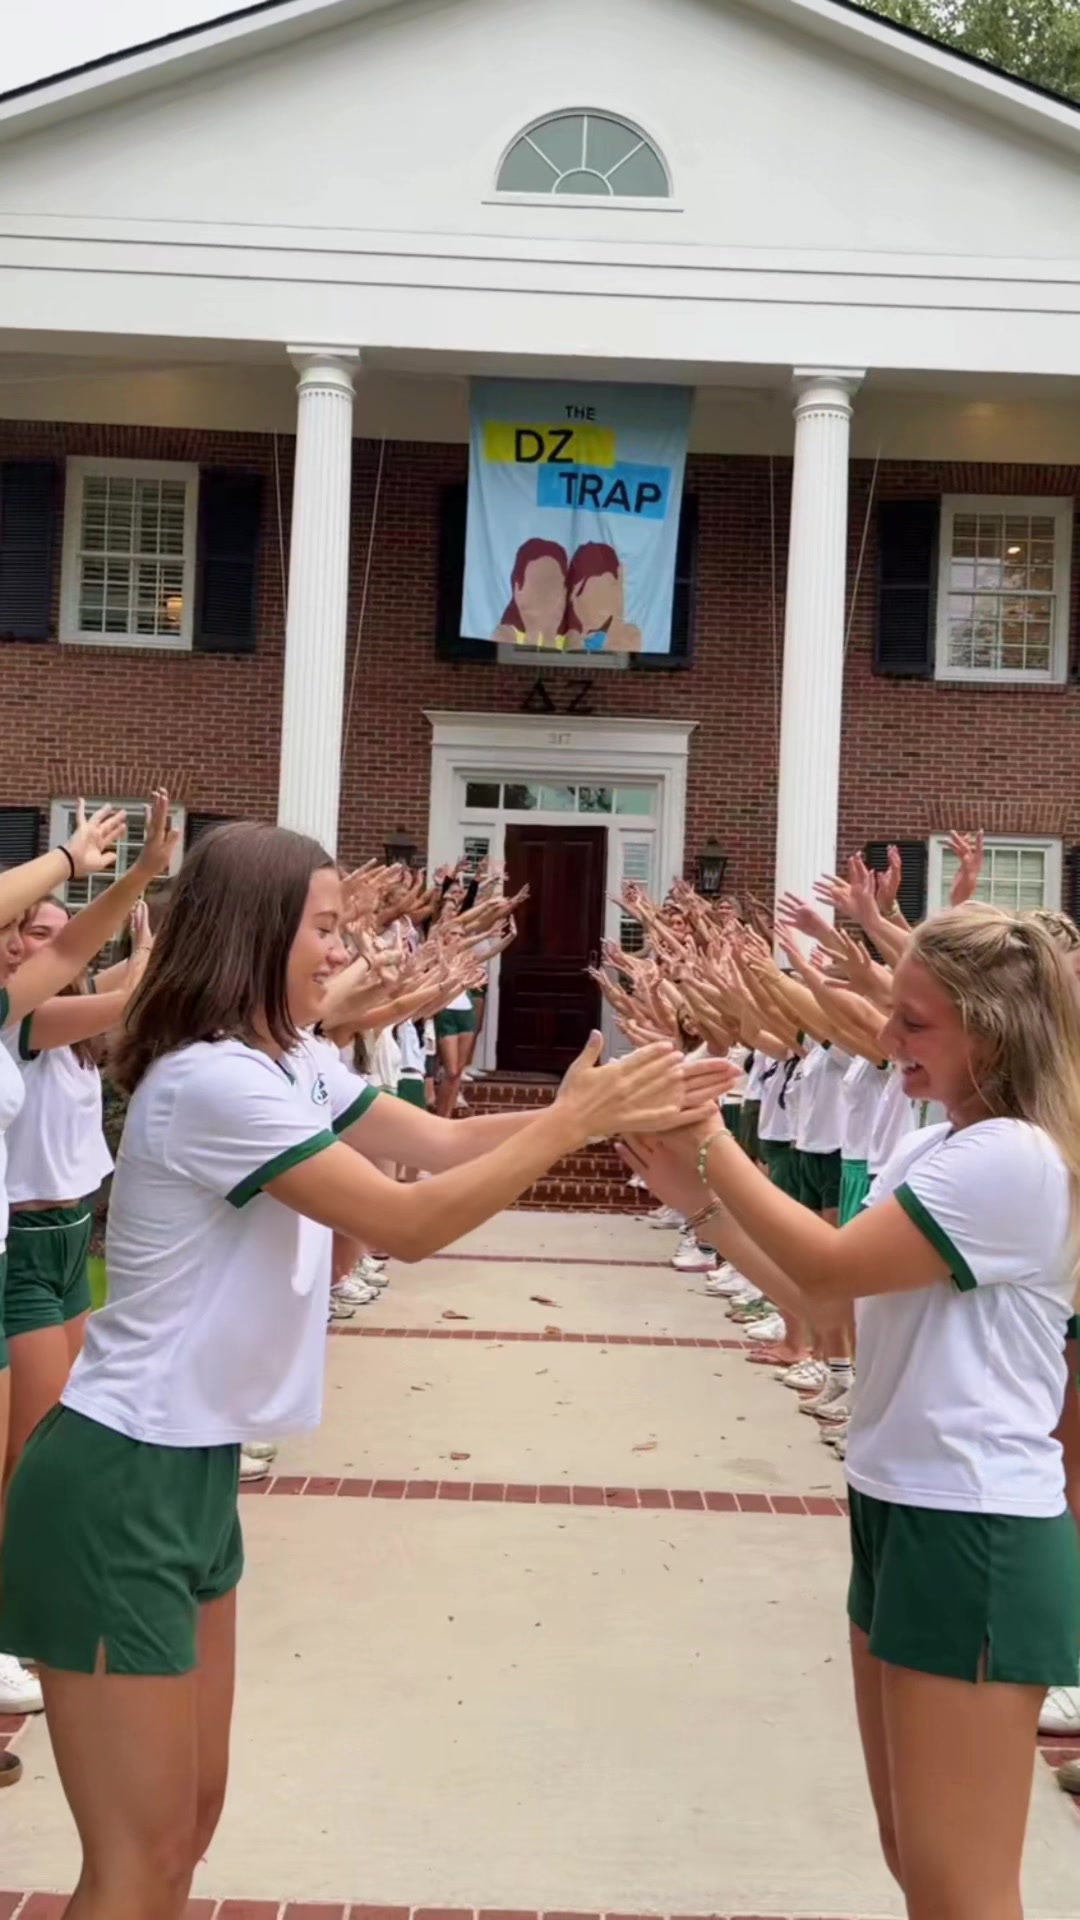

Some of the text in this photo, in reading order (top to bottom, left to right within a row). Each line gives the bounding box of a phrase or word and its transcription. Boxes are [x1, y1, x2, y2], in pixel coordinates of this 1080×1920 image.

[565, 405, 596, 420] THE
[515, 429, 574, 463] DZ
[559, 472, 662, 513] TRAP
